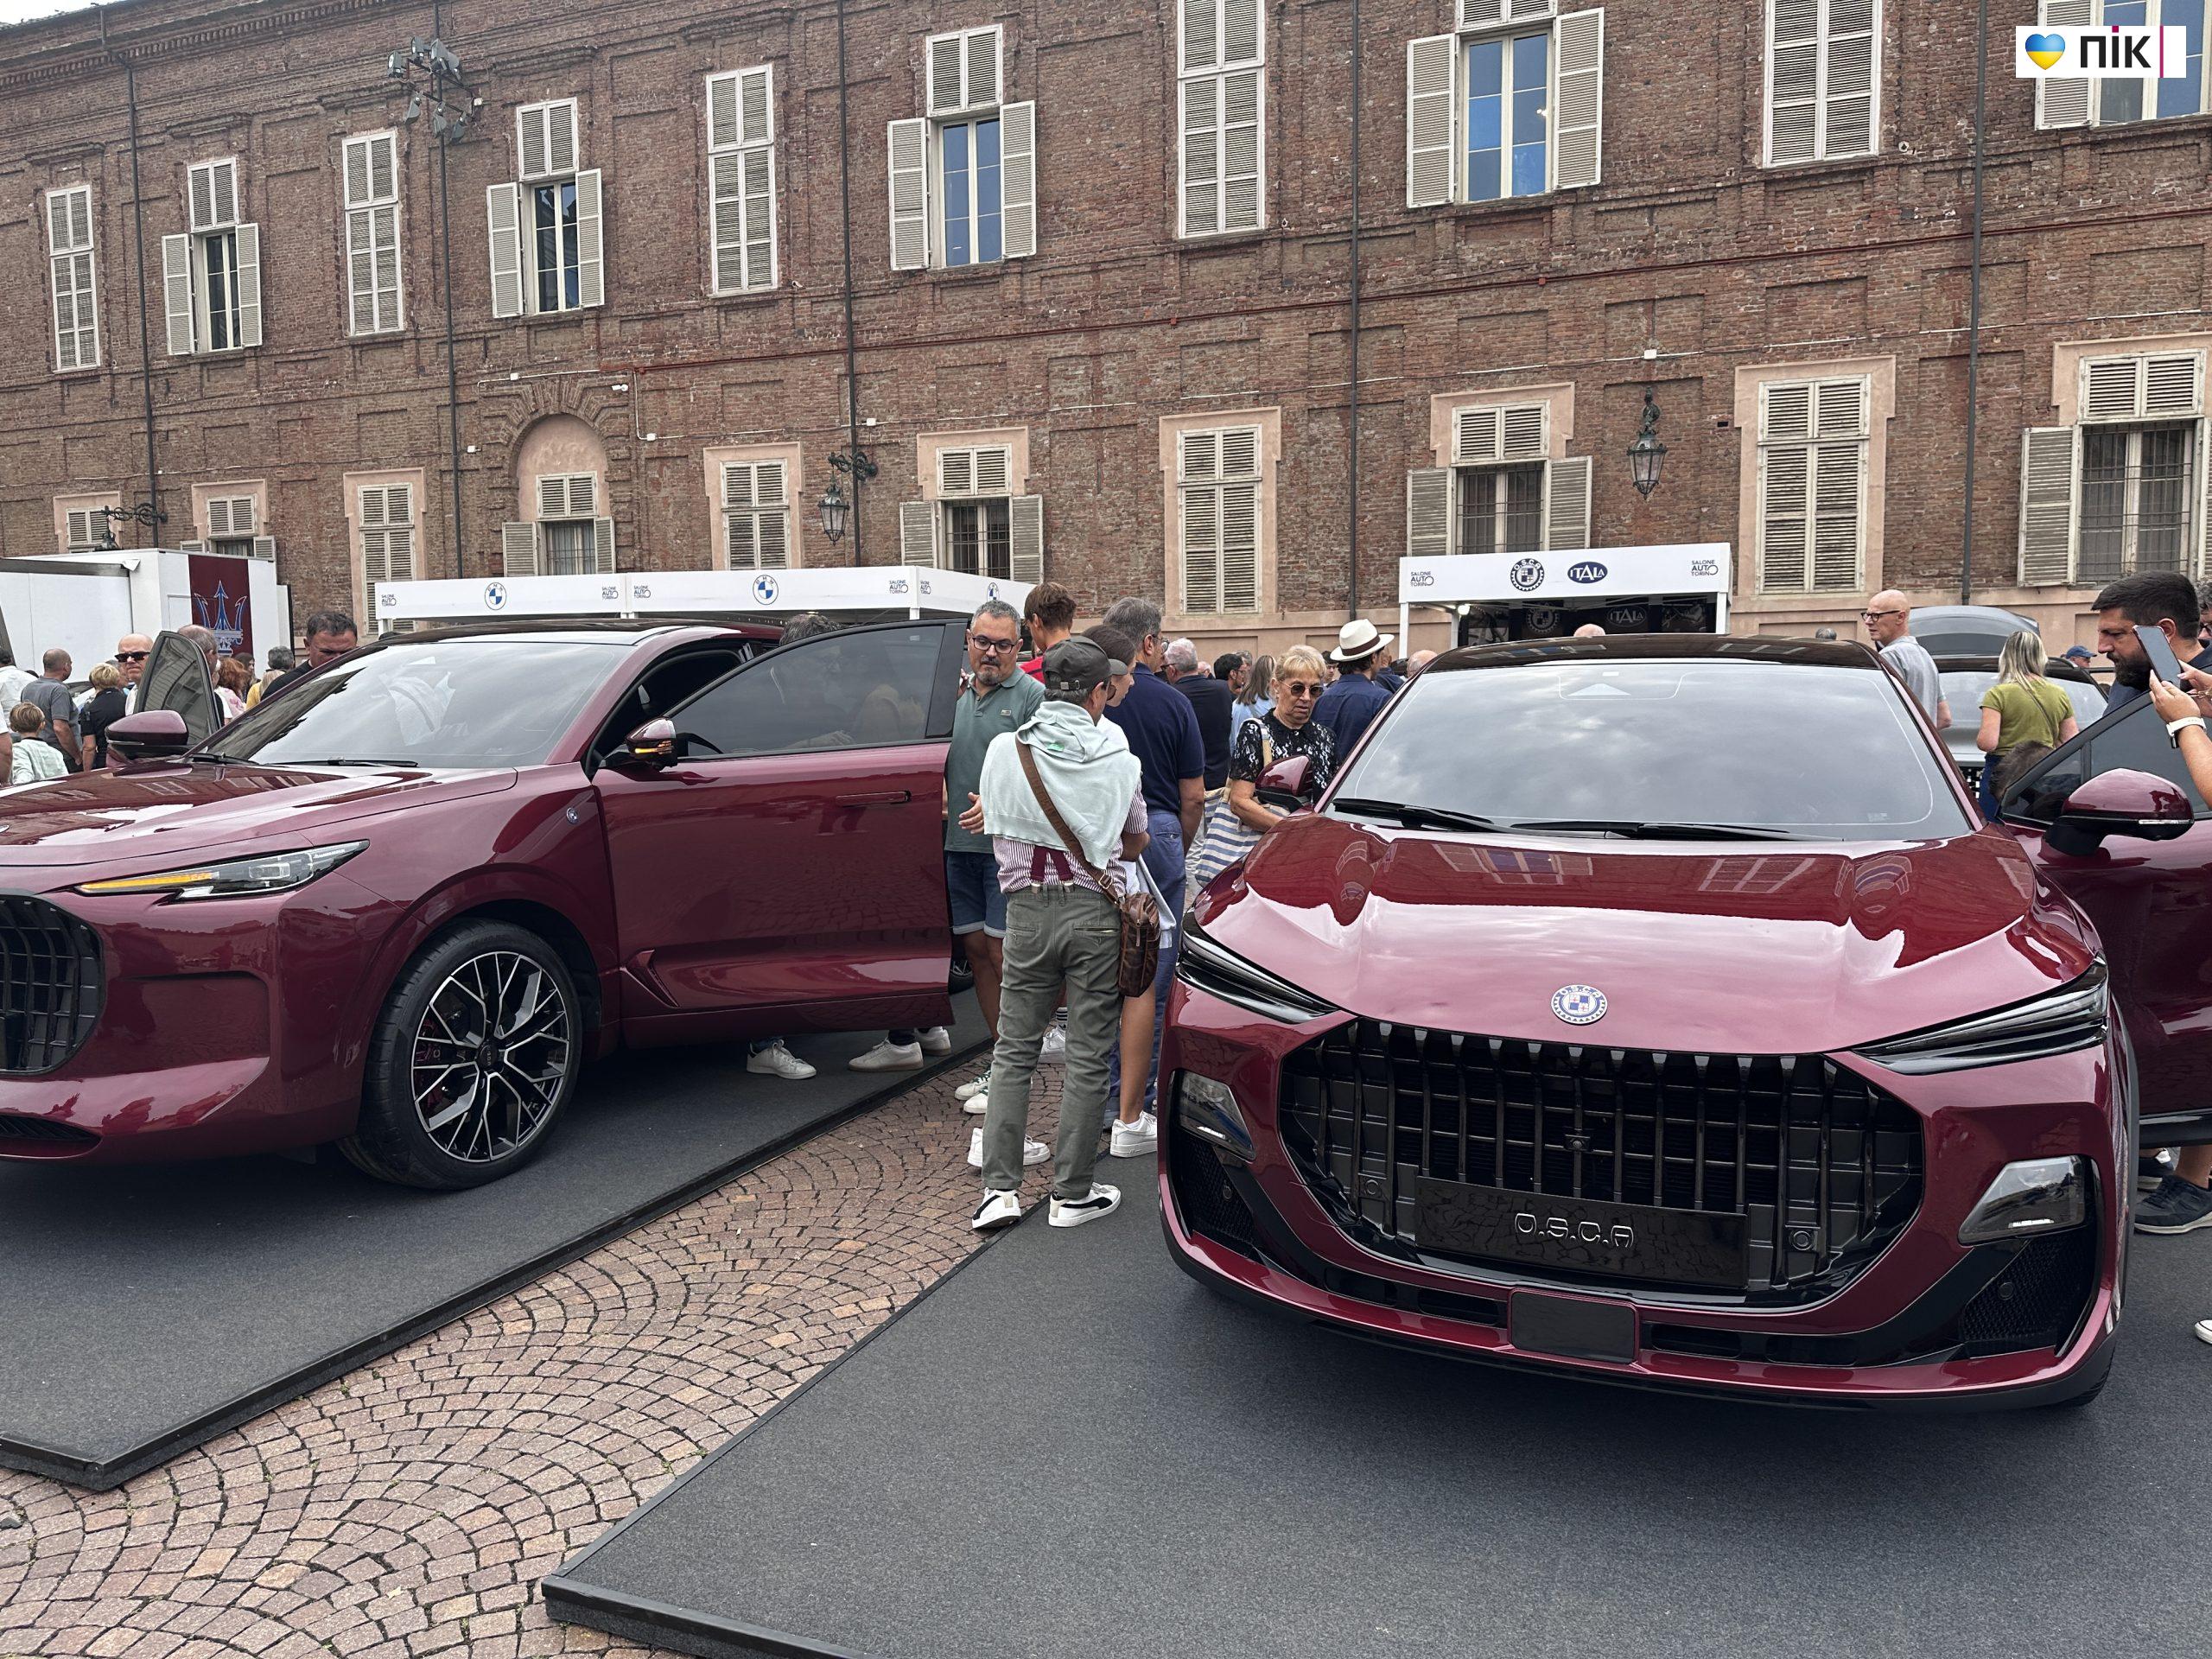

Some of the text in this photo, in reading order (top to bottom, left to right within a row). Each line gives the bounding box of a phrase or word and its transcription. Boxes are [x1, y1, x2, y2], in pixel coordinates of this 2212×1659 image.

[1570, 564, 1605, 582] ITALA
[1691, 564, 1719, 575] AUTO
[1410, 575, 1434, 585] AUTO
[889, 584, 908, 593] AUTO
[1609, 609, 1643, 624] ITALA
